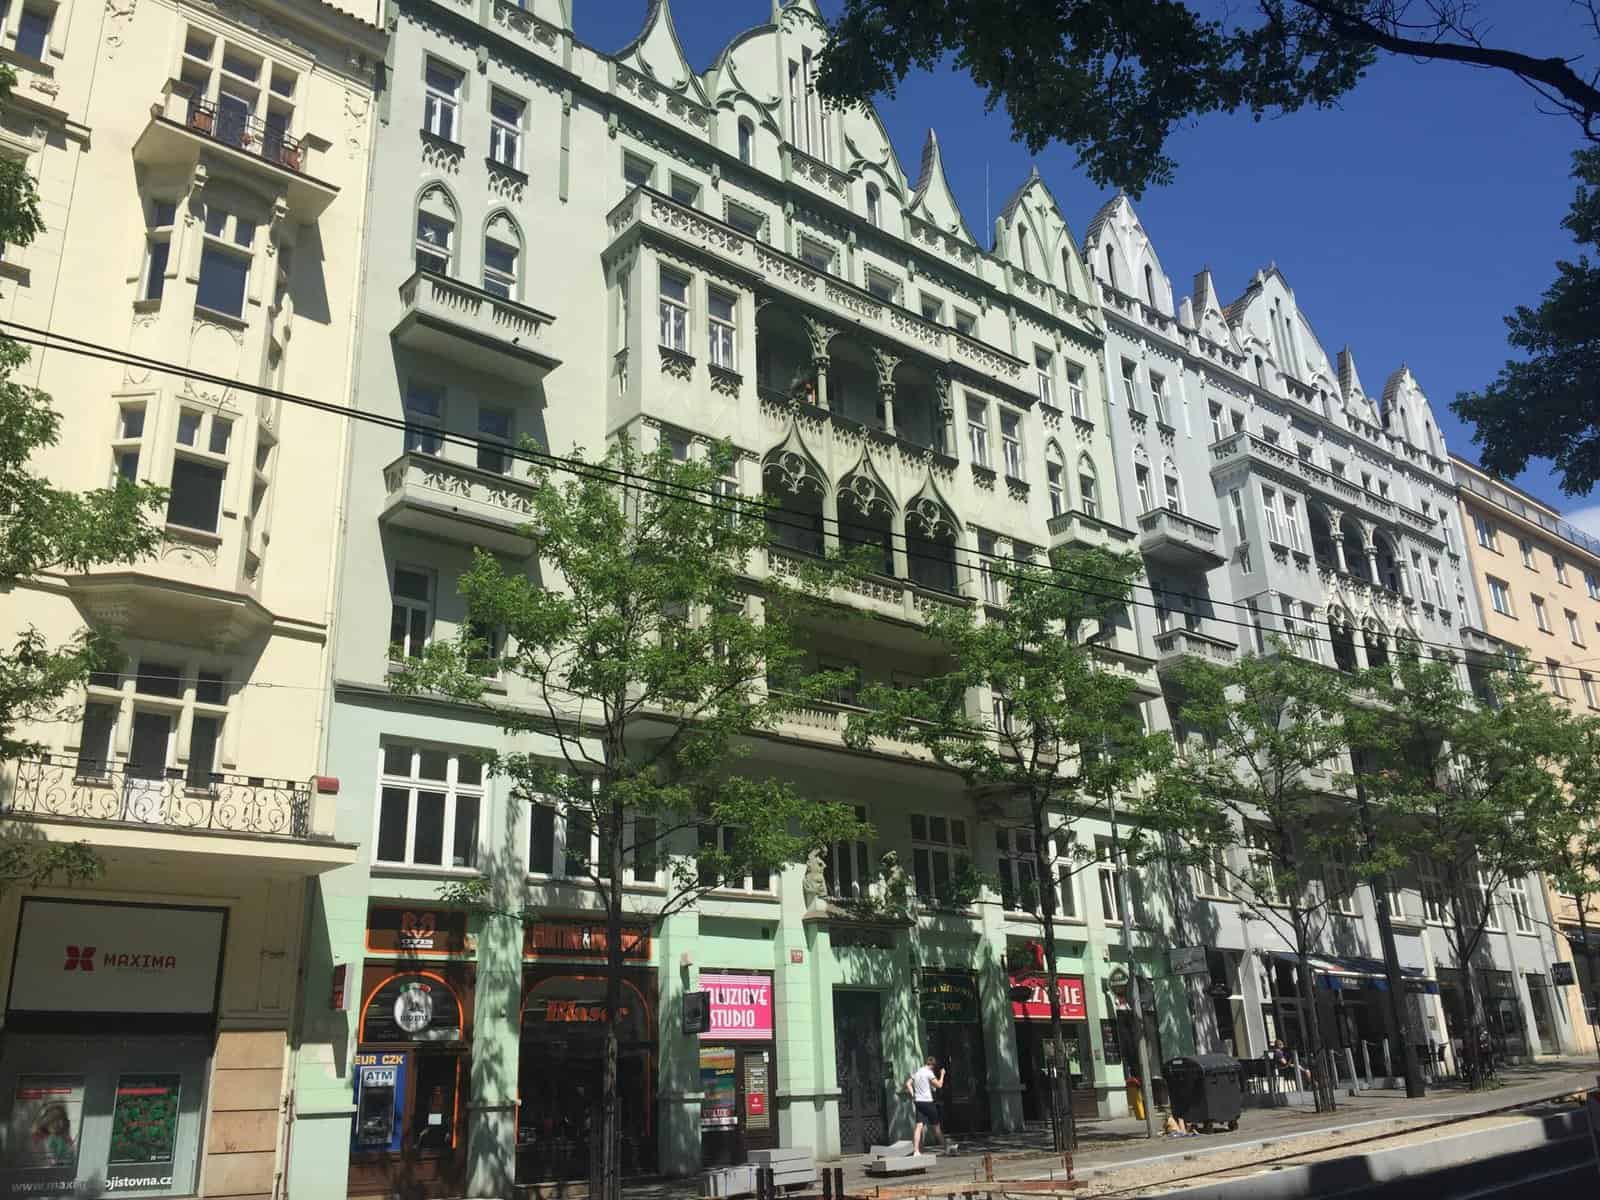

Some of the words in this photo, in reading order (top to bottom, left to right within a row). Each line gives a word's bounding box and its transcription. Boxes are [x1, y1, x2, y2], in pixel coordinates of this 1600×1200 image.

[103, 953, 177, 969] MAXIMA
[710, 1008, 756, 1028] STUDIO
[353, 1055, 377, 1065] EUR
[381, 1055, 404, 1065] CZK
[365, 1071, 393, 1081] ATM
